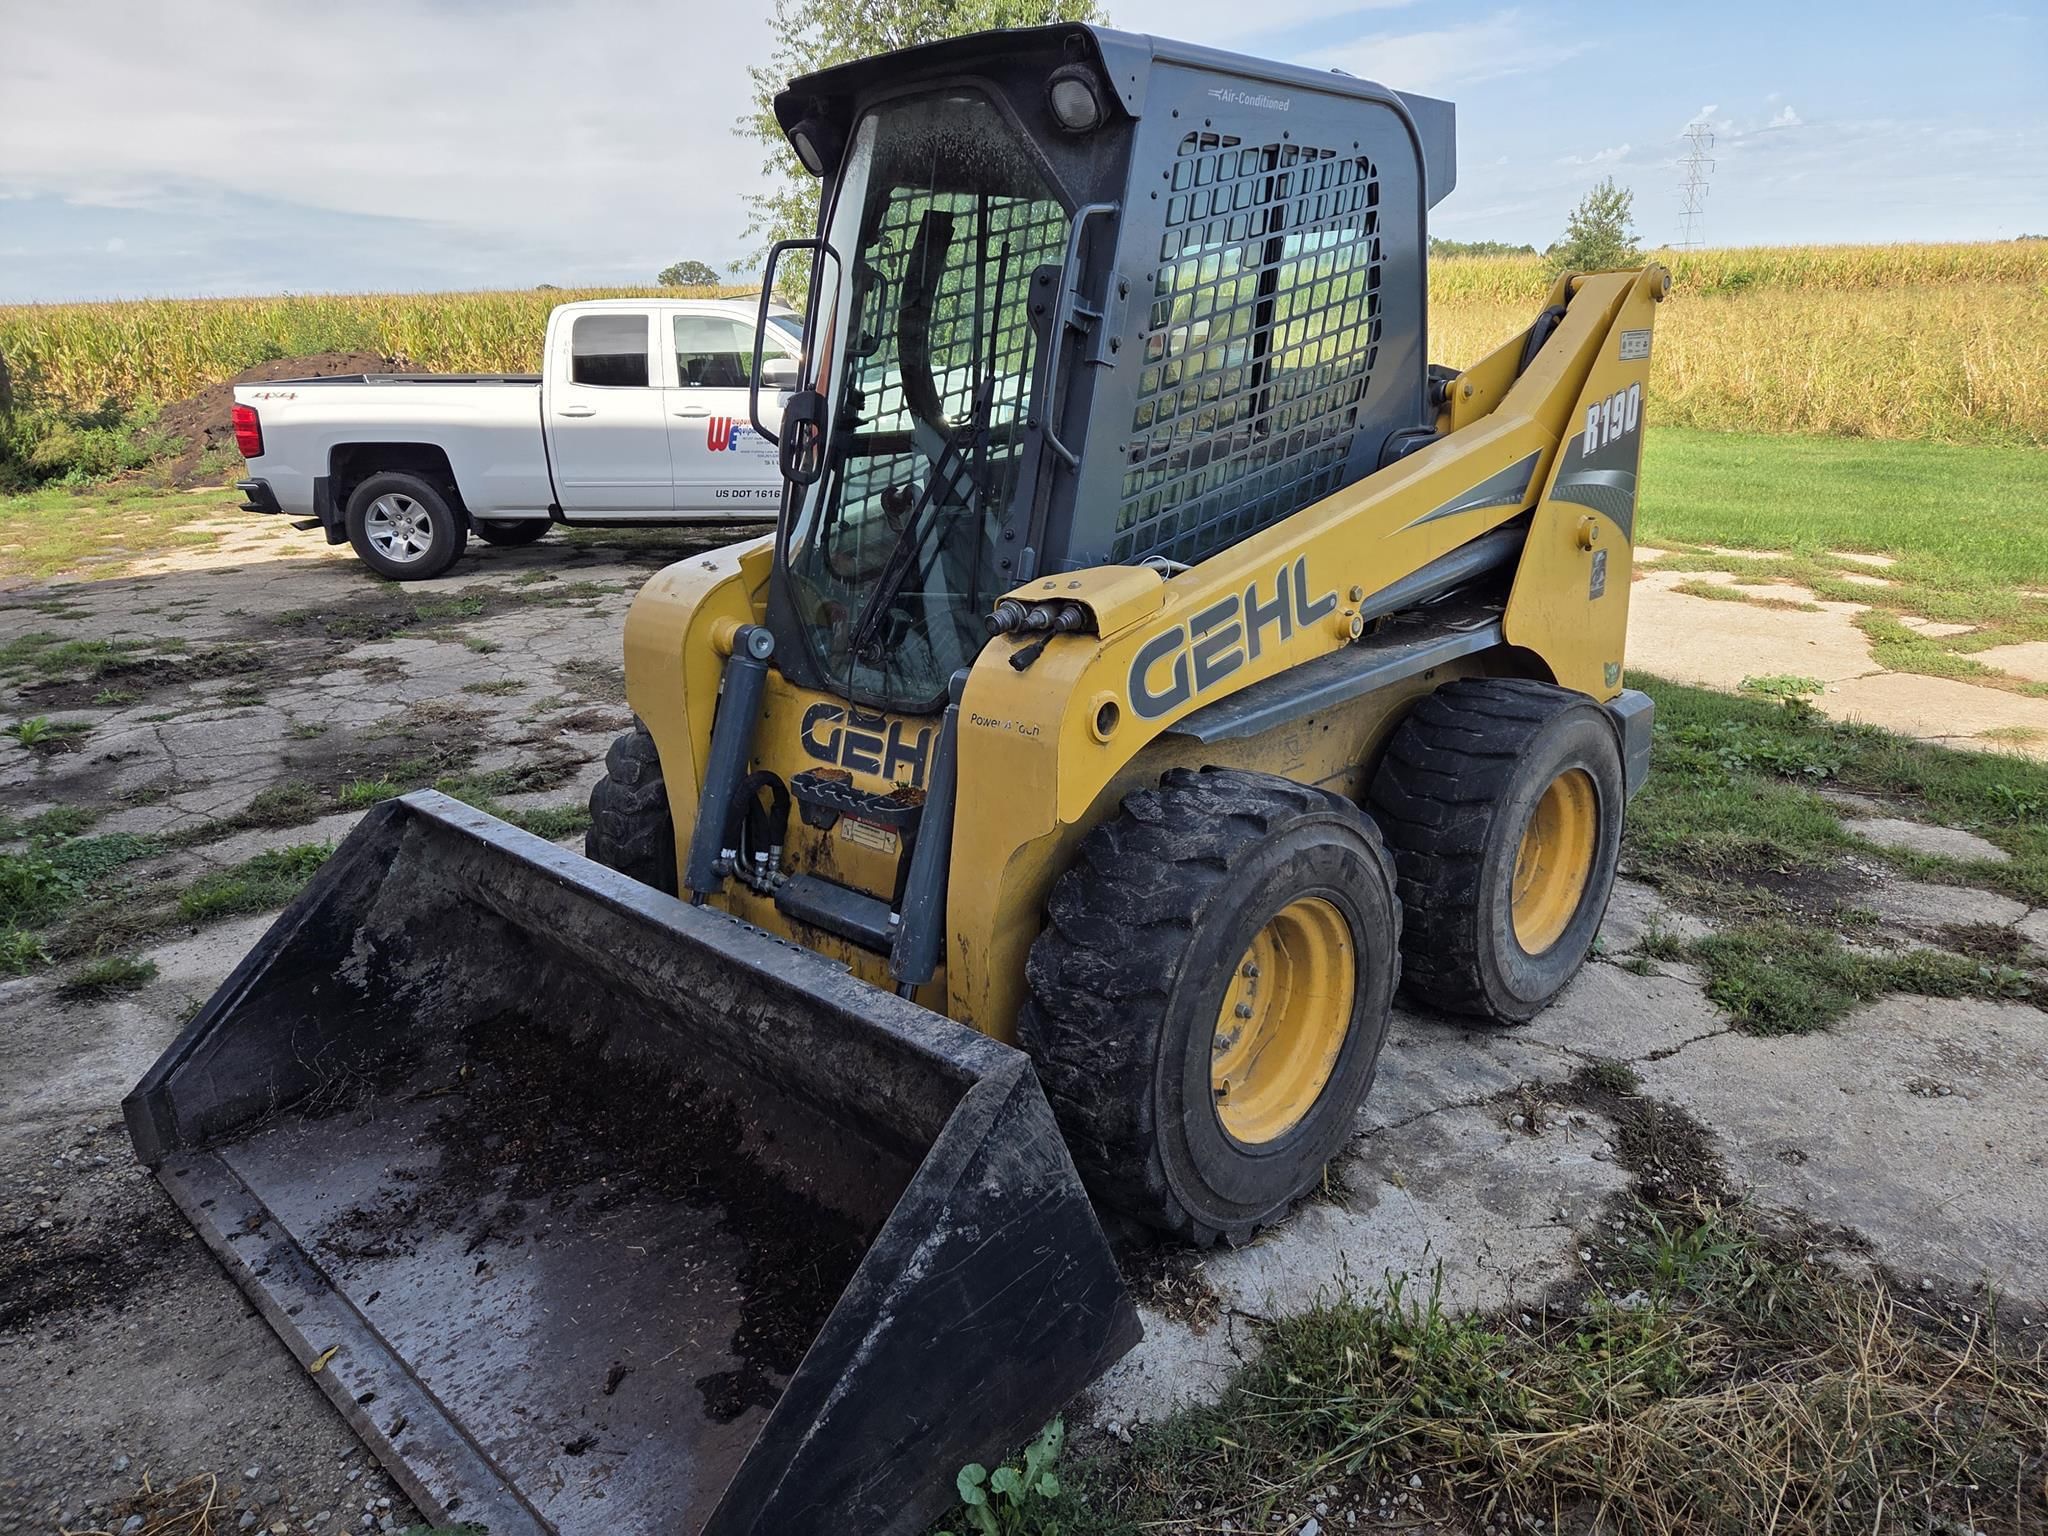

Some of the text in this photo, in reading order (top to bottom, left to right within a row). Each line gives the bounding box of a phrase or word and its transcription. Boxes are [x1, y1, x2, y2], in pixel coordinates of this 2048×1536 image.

[1221, 89, 1290, 112] Air-Conditioned
[1583, 382, 1641, 457] R190
[715, 489, 781, 498] US DOT 1616
[1128, 553, 1338, 720] GEHL
